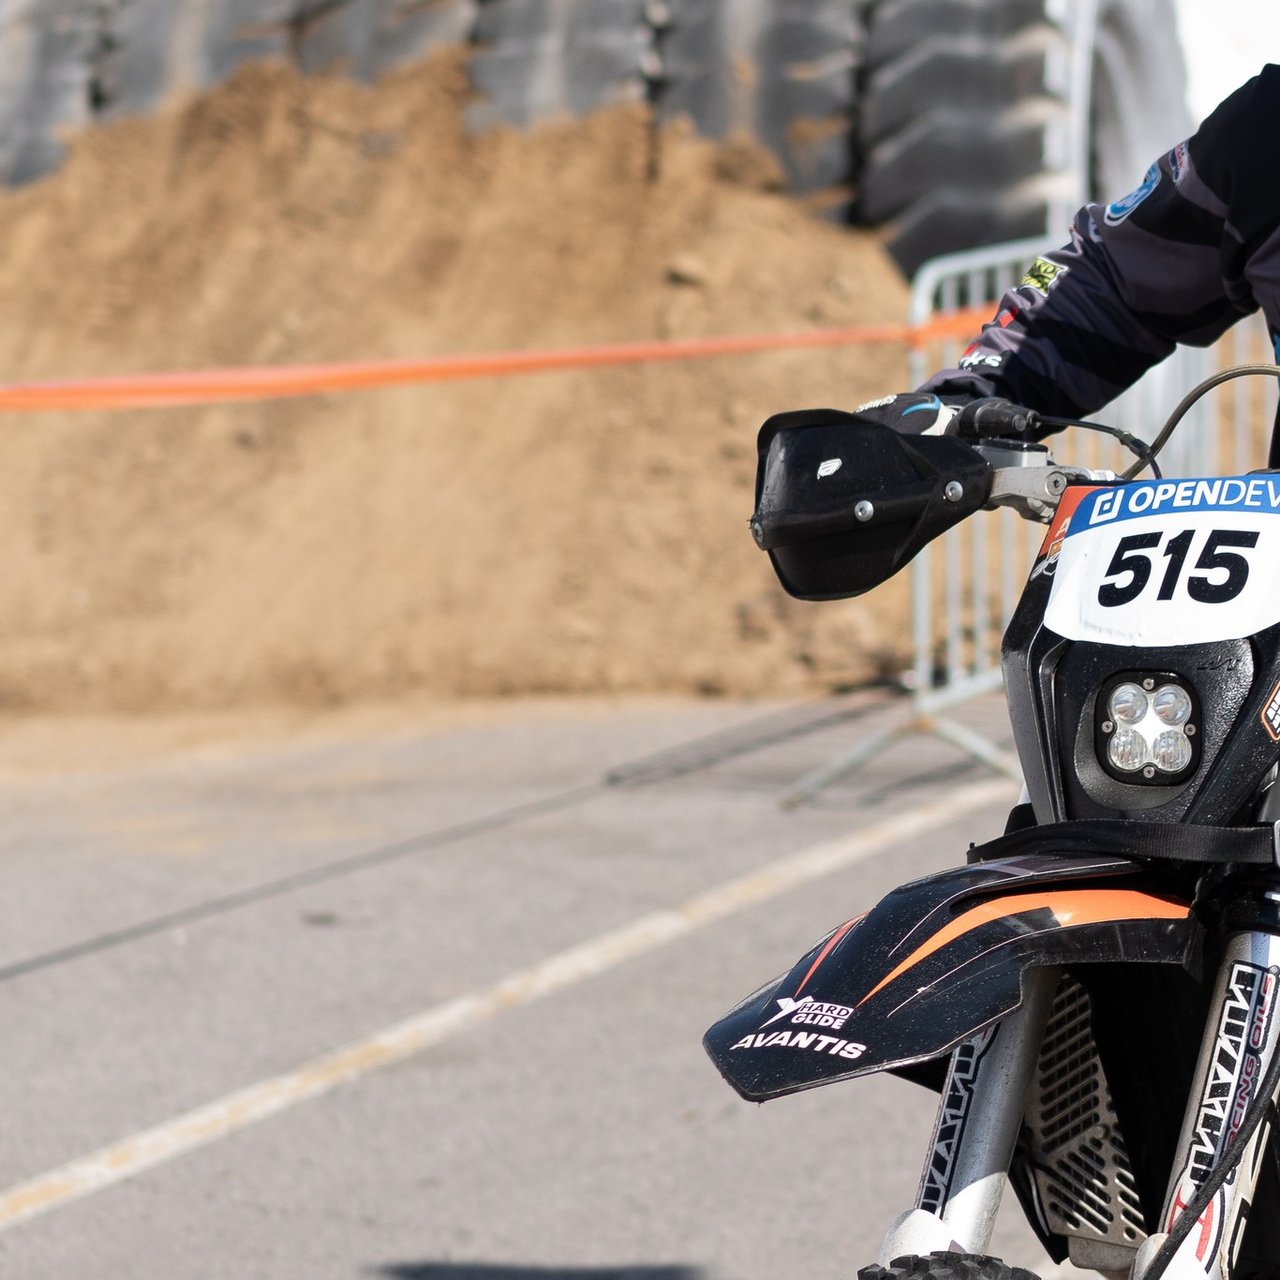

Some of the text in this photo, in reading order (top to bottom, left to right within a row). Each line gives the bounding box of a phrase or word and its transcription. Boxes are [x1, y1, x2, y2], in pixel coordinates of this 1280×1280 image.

[1097, 528, 1261, 608] 515
[791, 1013, 846, 1030] GLIDE
[800, 1002, 850, 1018] HARD
[1250, 973, 1273, 1051] OILS
[729, 1030, 867, 1060] AVANTIS
